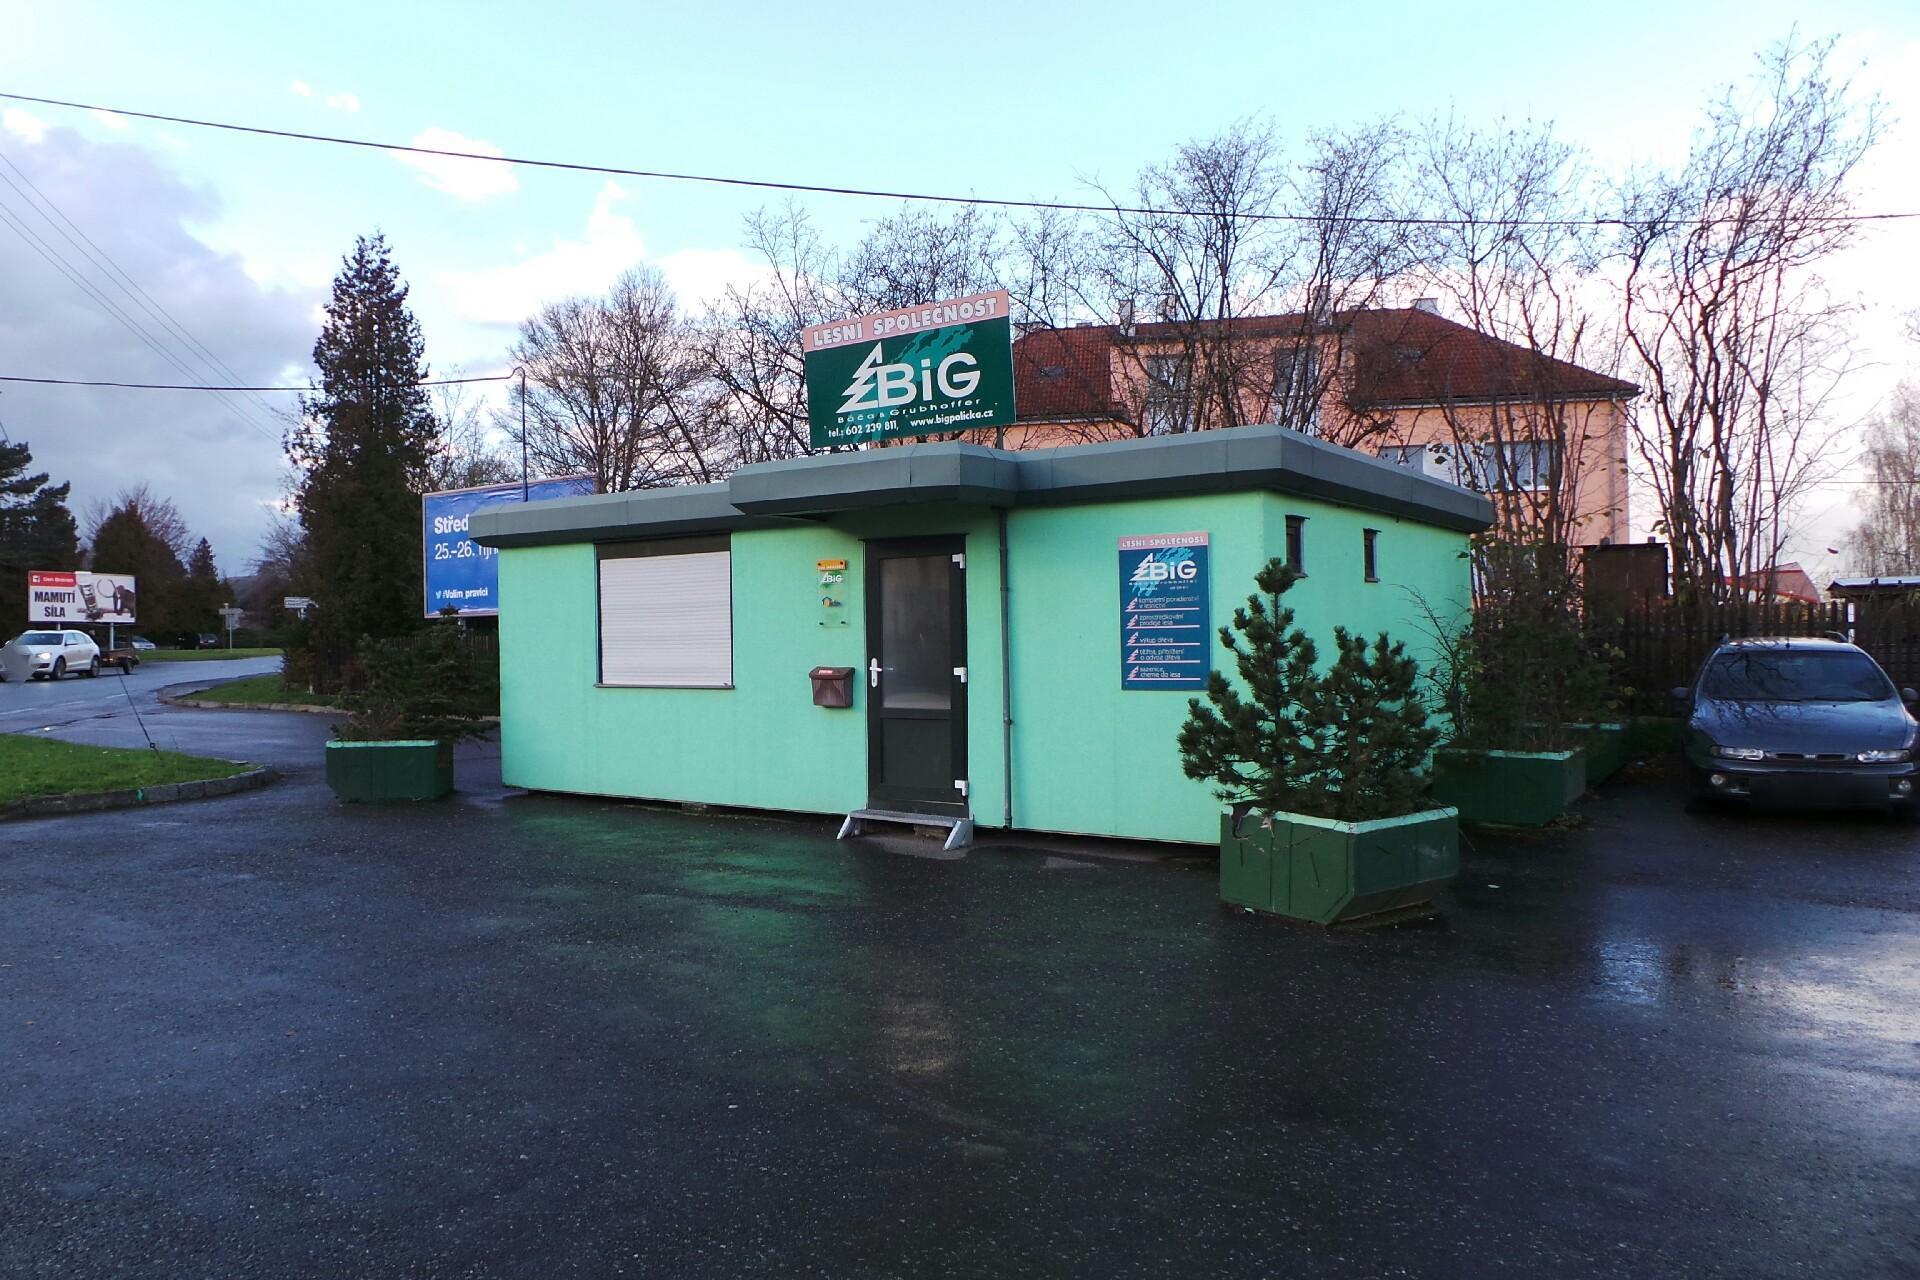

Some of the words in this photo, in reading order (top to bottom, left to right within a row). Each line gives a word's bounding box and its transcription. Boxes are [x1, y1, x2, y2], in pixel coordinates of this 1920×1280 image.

[812, 321, 864, 347] LESNÍ
[873, 297, 998, 335] SPOLEČNOST
[889, 398, 981, 416] Grubhoffer
[845, 425, 863, 436] 602
[865, 422, 882, 433] 239
[884, 420, 899, 432] 811,
[910, 408, 994, 428] www.bigpolicka.cz
[34, 590, 76, 604] MAMUTÍ
[44, 604, 66, 618] SÍLA
